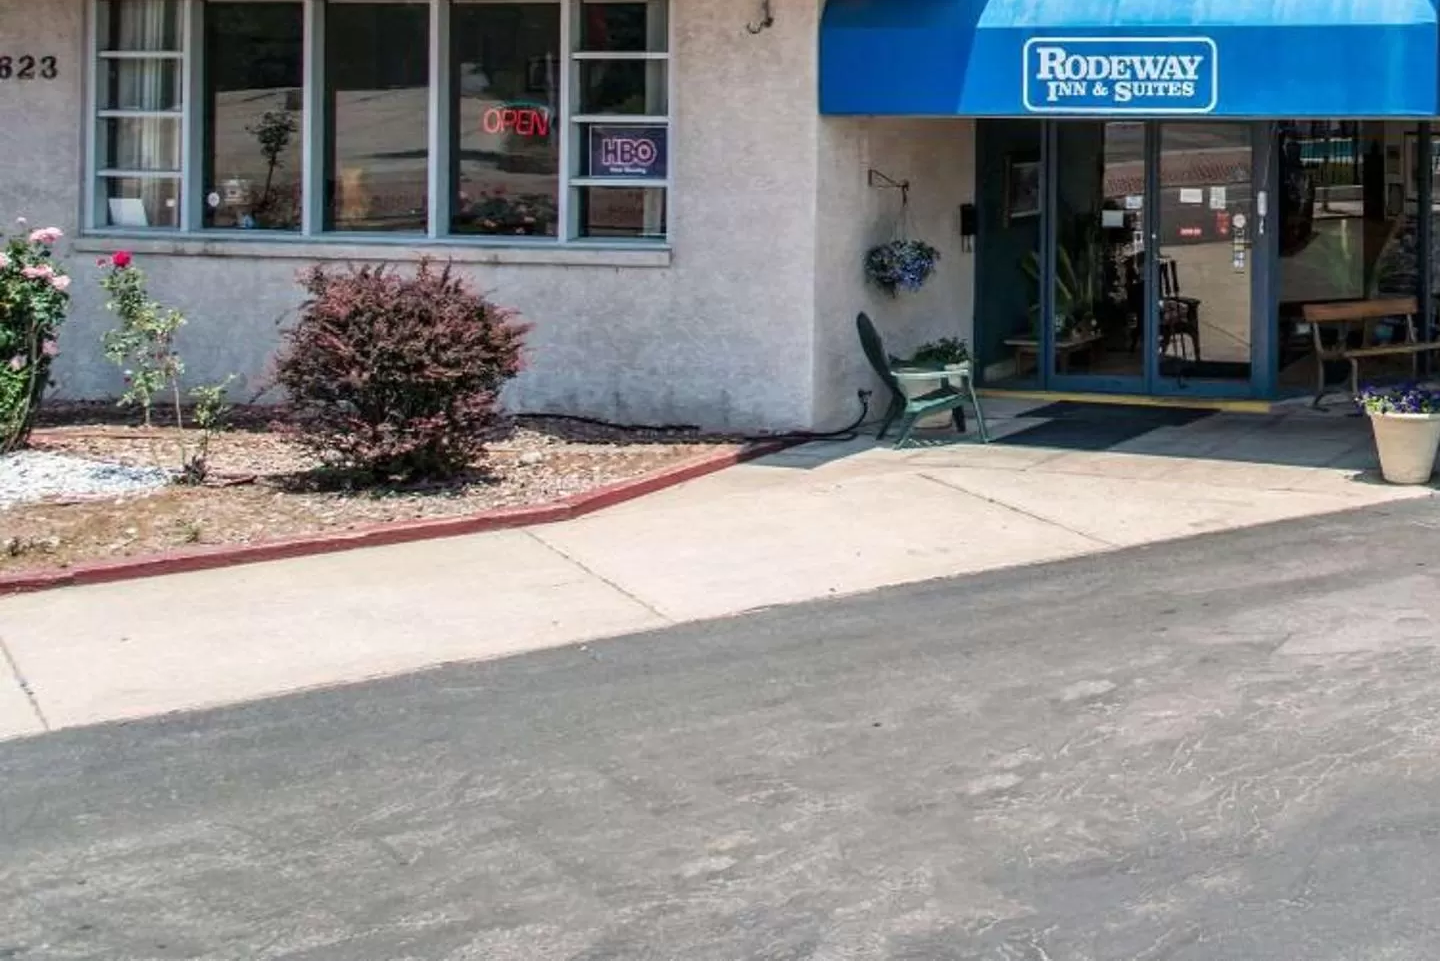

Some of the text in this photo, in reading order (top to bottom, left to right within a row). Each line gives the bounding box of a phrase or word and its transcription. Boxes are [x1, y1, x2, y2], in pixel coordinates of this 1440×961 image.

[1036, 46, 1204, 80] RODEWAY
[1046, 80, 1195, 102] INN & SUITES
[483, 107, 549, 137] OPEN
[602, 138, 657, 166] HBO
